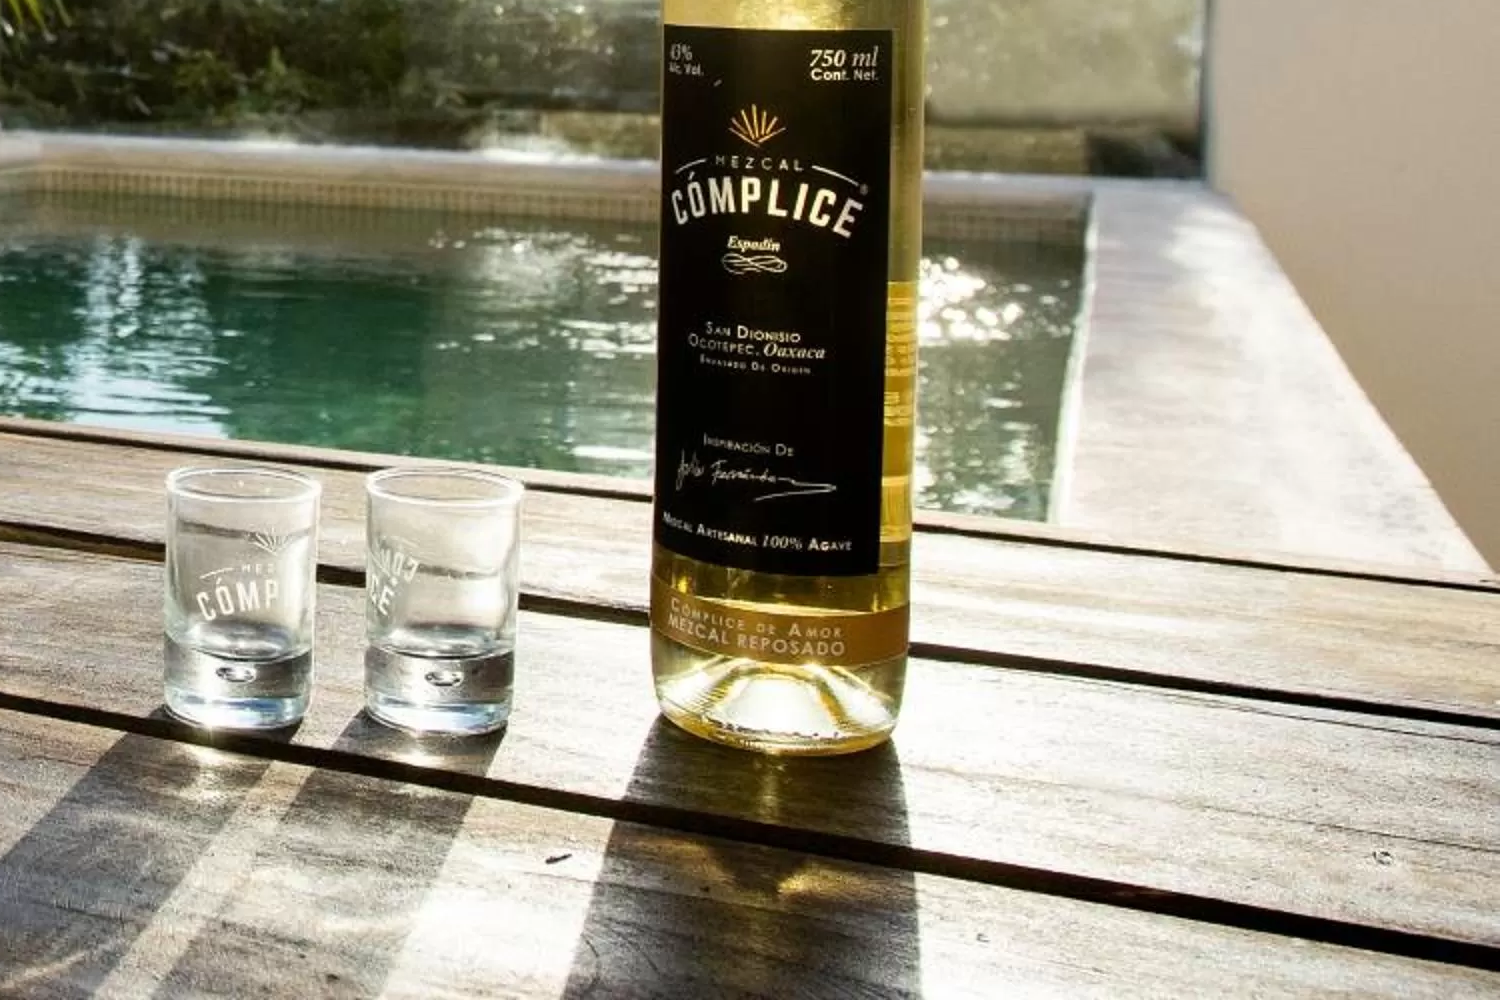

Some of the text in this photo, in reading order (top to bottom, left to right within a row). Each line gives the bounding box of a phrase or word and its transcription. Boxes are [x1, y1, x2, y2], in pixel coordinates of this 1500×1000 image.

[809, 45, 879, 67] 750 ml
[810, 69, 849, 81] Cont.
[715, 155, 804, 172] MEZCAL
[671, 171, 864, 239] CÓMPLICE
[763, 342, 826, 360] Oaxaca
[762, 535, 803, 550] 100%
[667, 613, 846, 656] MEZCAL REPOSADO
